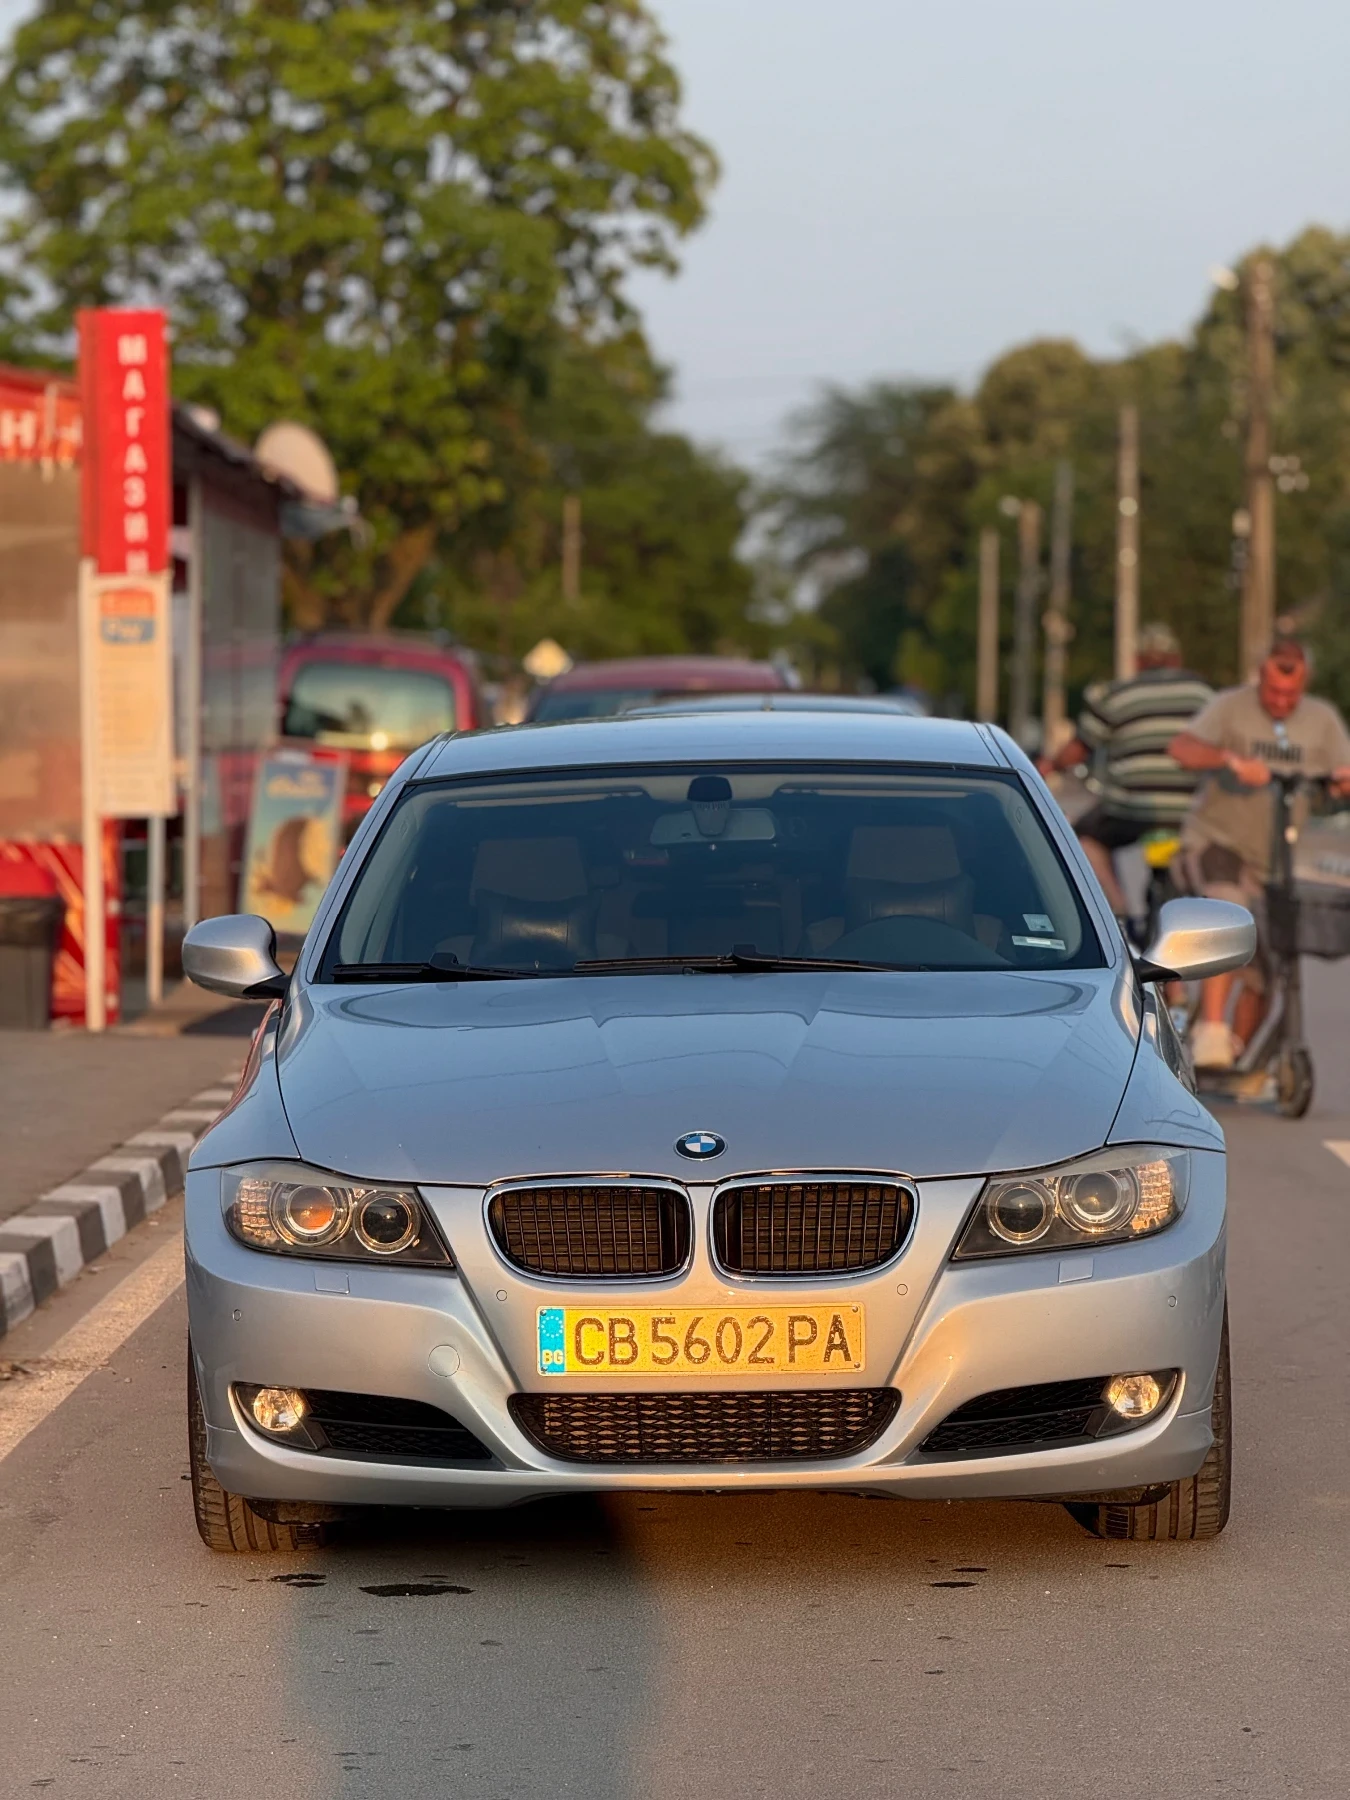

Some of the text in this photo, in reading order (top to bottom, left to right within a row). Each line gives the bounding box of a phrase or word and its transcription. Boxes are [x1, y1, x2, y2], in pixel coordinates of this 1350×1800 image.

[575, 1314, 852, 1365] CB 5602 PA
[542, 1350, 564, 1365] BG
